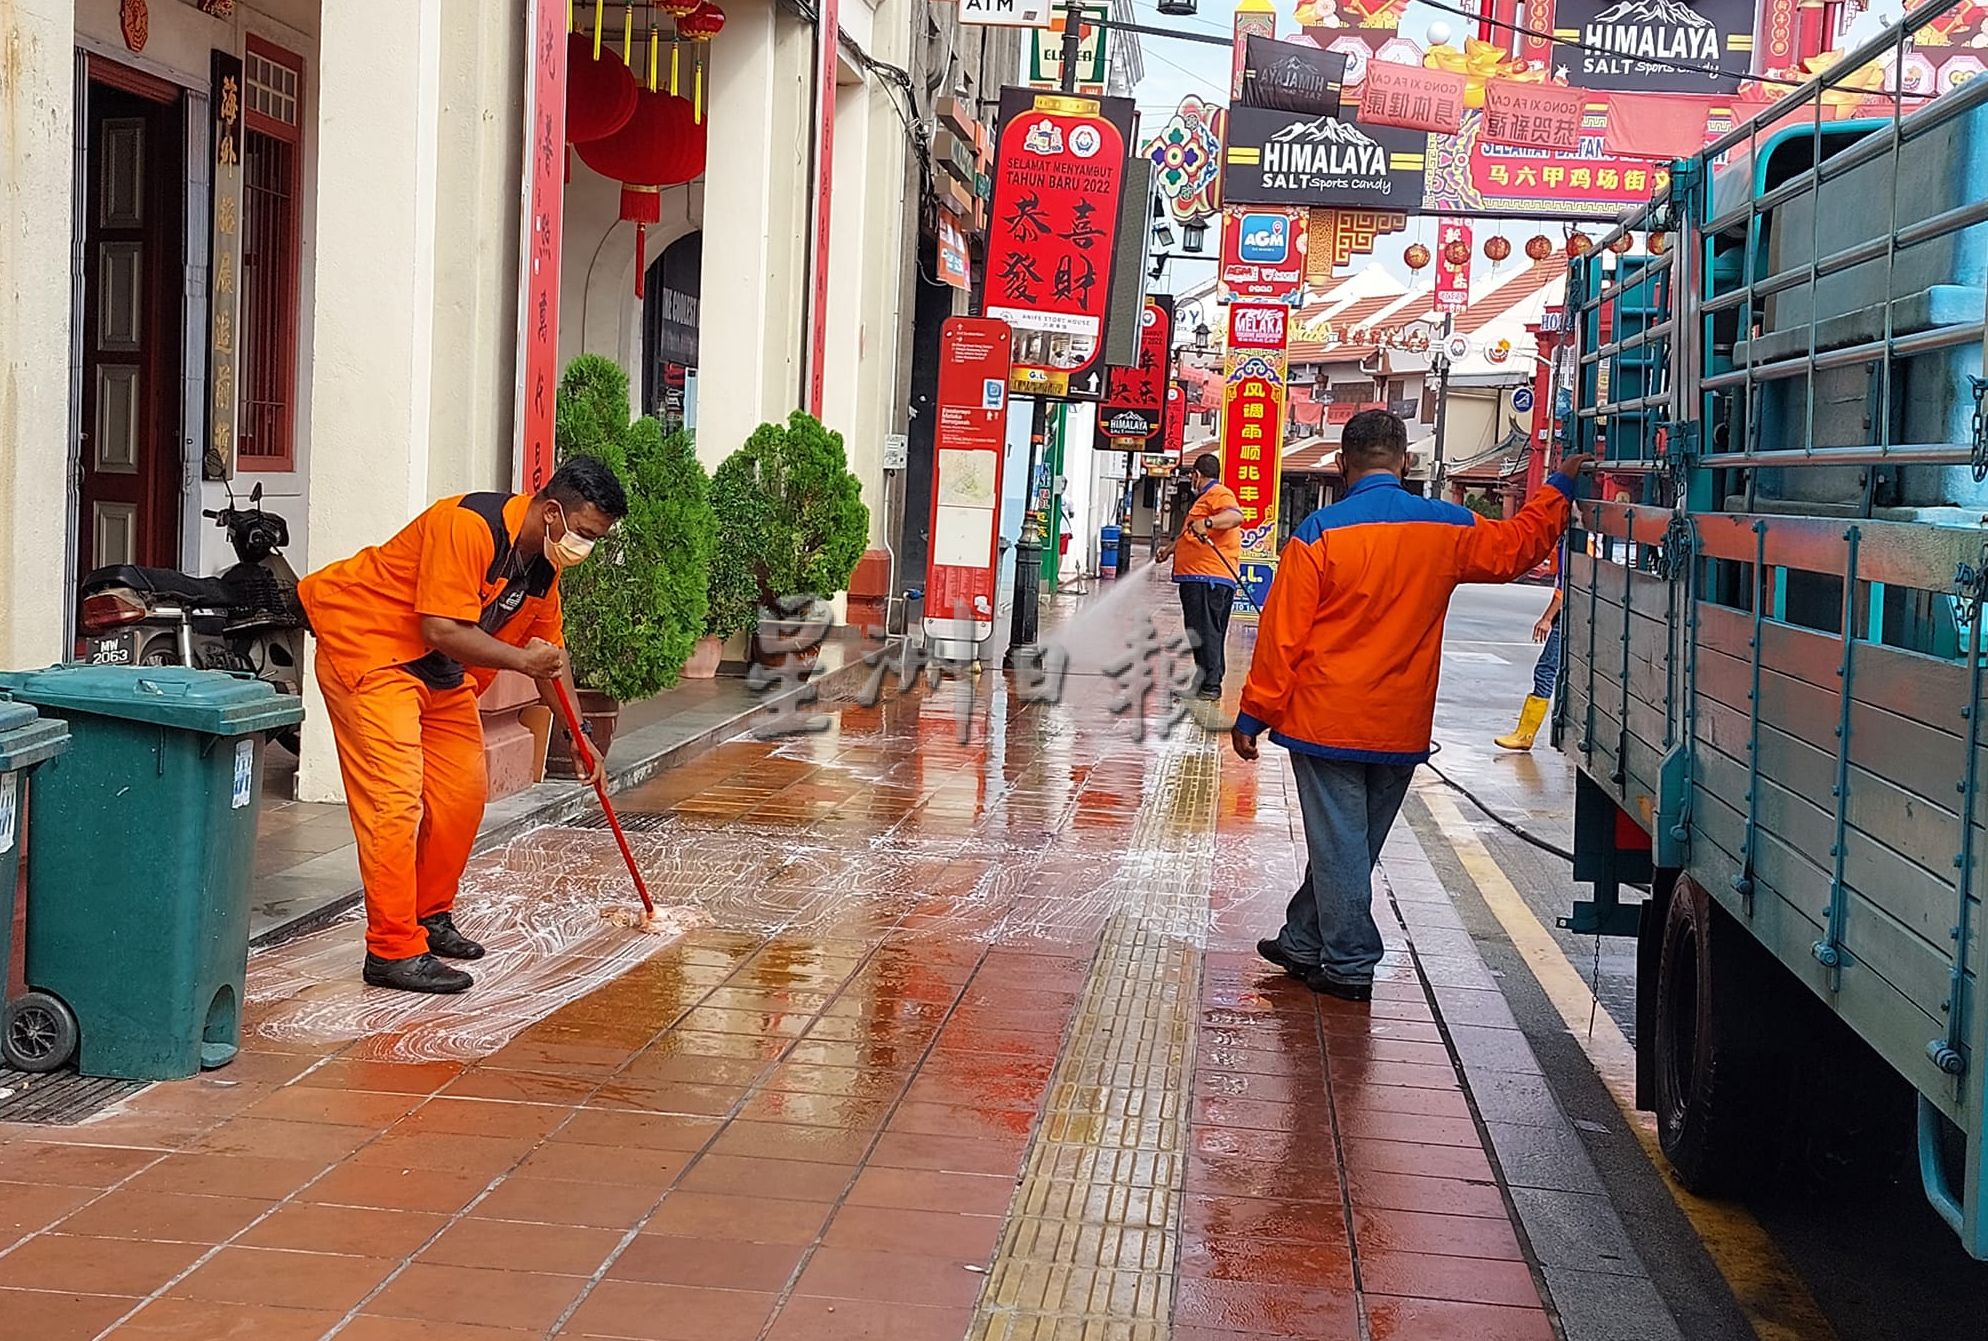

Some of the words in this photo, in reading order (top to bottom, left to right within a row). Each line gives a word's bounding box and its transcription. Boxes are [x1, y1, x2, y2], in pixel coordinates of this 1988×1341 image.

[1584, 24, 1719, 59] HIMALAYA
[1583, 58, 1634, 74] SALT
[1007, 158, 1051, 172] SELAMAT
[1054, 162, 1113, 178] MENYAMBUT
[1262, 143, 1387, 176] HIMALAYA
[1007, 171, 1046, 187] TAHUN
[1049, 175, 1080, 191] BARU
[1083, 180, 1110, 194] 2022
[1262, 174, 1311, 189] SALT
[1310, 176, 1349, 192] Sports
[1001, 191, 1107, 250] 恭喜
[1244, 230, 1285, 247] AGM
[998, 252, 1097, 311] 發財
[1234, 318, 1284, 334] MELAKA
[1110, 419, 1148, 431] HIMALAYA
[100, 638, 119, 652] MW
[92, 650, 128, 665] 2063
